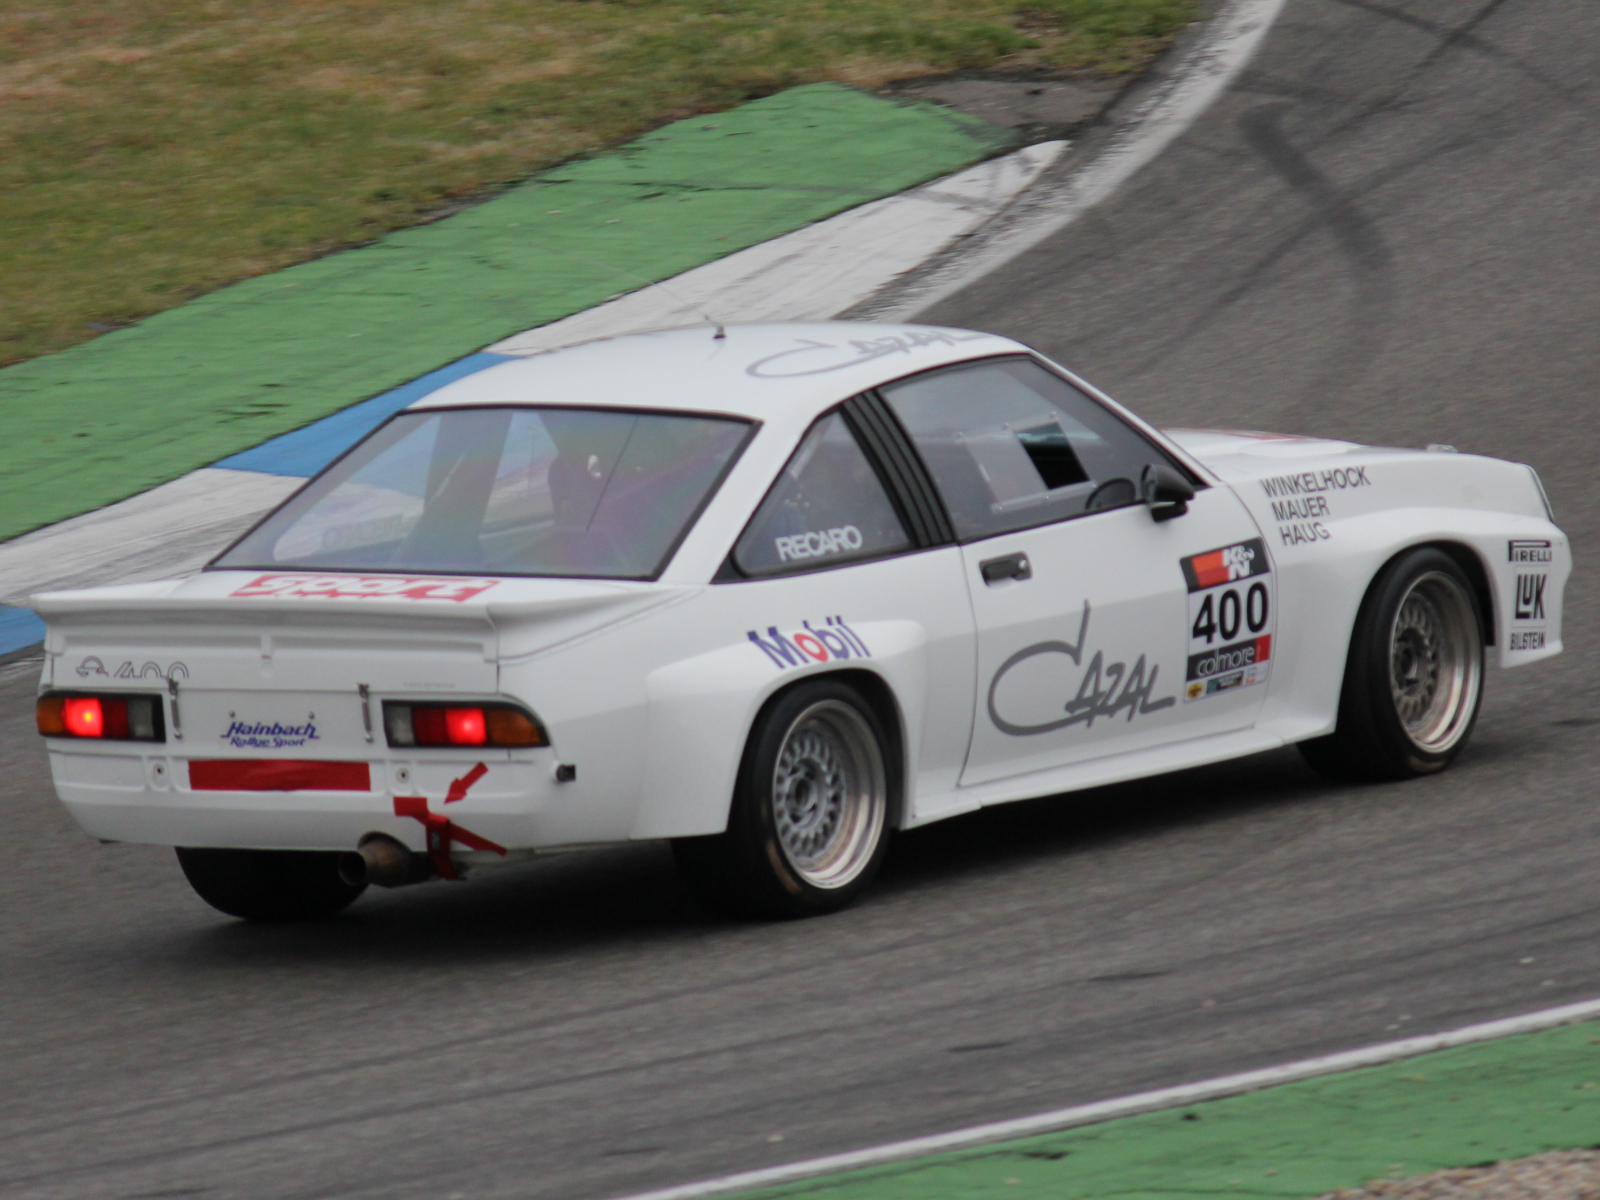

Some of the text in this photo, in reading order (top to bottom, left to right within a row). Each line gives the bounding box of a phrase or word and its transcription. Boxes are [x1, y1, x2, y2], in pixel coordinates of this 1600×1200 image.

[1260, 466, 1371, 498] WINKELHOCK
[1271, 496, 1331, 521] MAUER
[775, 524, 862, 562] RECARO
[1279, 522, 1332, 546] HAUG
[1508, 540, 1552, 562] PIRELLI
[1193, 581, 1269, 644] 400
[747, 615, 871, 669] Mobil
[1510, 632, 1546, 651] BILSTEIN
[1196, 646, 1255, 677] colmore
[220, 721, 320, 739] Hainbach
